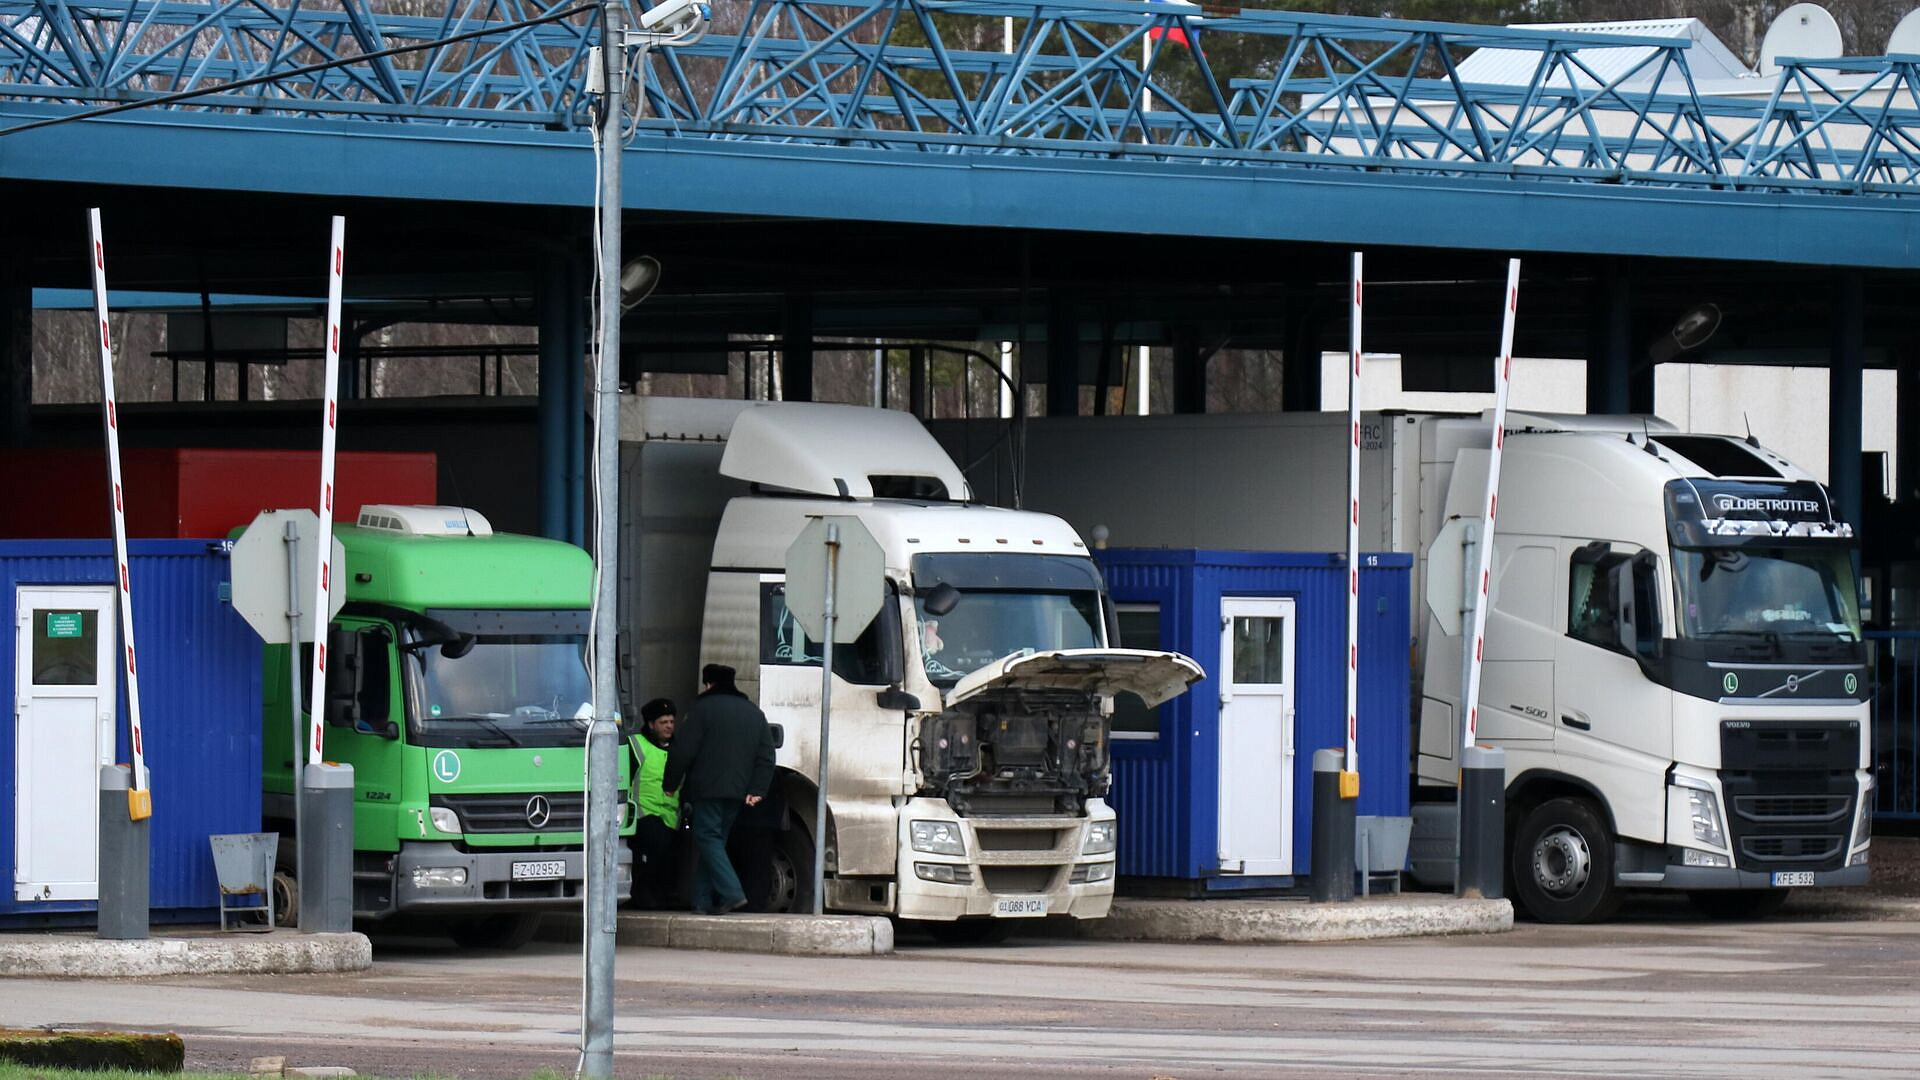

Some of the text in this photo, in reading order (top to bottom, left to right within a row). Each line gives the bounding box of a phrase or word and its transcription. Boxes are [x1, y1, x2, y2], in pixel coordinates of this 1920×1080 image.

[1719, 498, 1819, 512] GLOBETROTTER
[221, 540, 233, 552] 16
[1367, 555, 1378, 566] 15
[1525, 706, 1548, 718] 500
[441, 756, 453, 776] L
[366, 791, 391, 800] 1224
[520, 862, 560, 876] Z-02952
[1777, 872, 1814, 885] KFE 532
